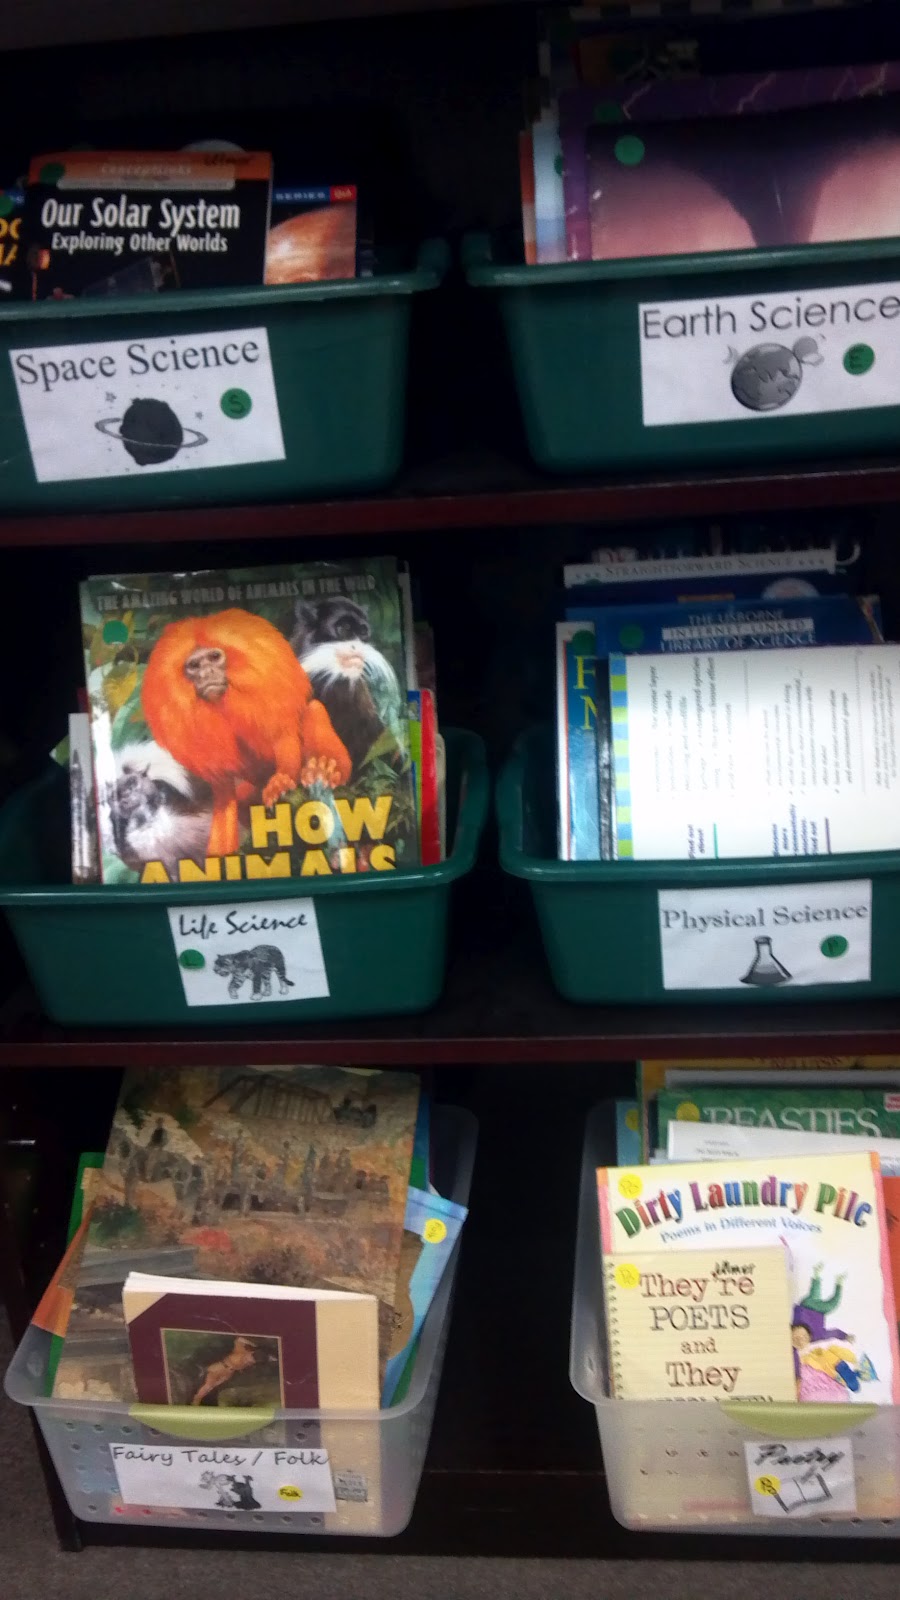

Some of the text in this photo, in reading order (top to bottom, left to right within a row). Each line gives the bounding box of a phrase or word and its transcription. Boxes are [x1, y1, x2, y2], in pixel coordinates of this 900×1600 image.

[41, 198, 84, 229] Our
[90, 194, 152, 228] Solar
[158, 198, 241, 238] System
[51, 230, 229, 256] Exploring Other Worlds
[643, 297, 900, 339] Earth Science
[16, 340, 260, 392] Space Science
[849, 346, 865, 369] E
[228, 394, 245, 415] S
[605, 554, 796, 578] STRAIGHTFORWARD SCIENCE
[97, 574, 376, 611] THE AMAZING WORLD OF ANIMALS IN THE WILD
[688, 609, 784, 626] THE USBORNE
[660, 631, 816, 652] LIBRARY OF SCIENCE
[250, 796, 393, 848] HOW
[179, 910, 308, 939] Life Science
[661, 905, 868, 933] Physical Science
[615, 1175, 873, 1239] Dirty Laundry Pile
[660, 1215, 824, 1244] Poems in Different Voices
[639, 1271, 755, 1303] They're
[649, 1304, 751, 1332] POETS
[680, 1336, 718, 1355] and
[665, 1361, 742, 1393] They
[112, 1446, 330, 1466] Fairy Tales / Folk
